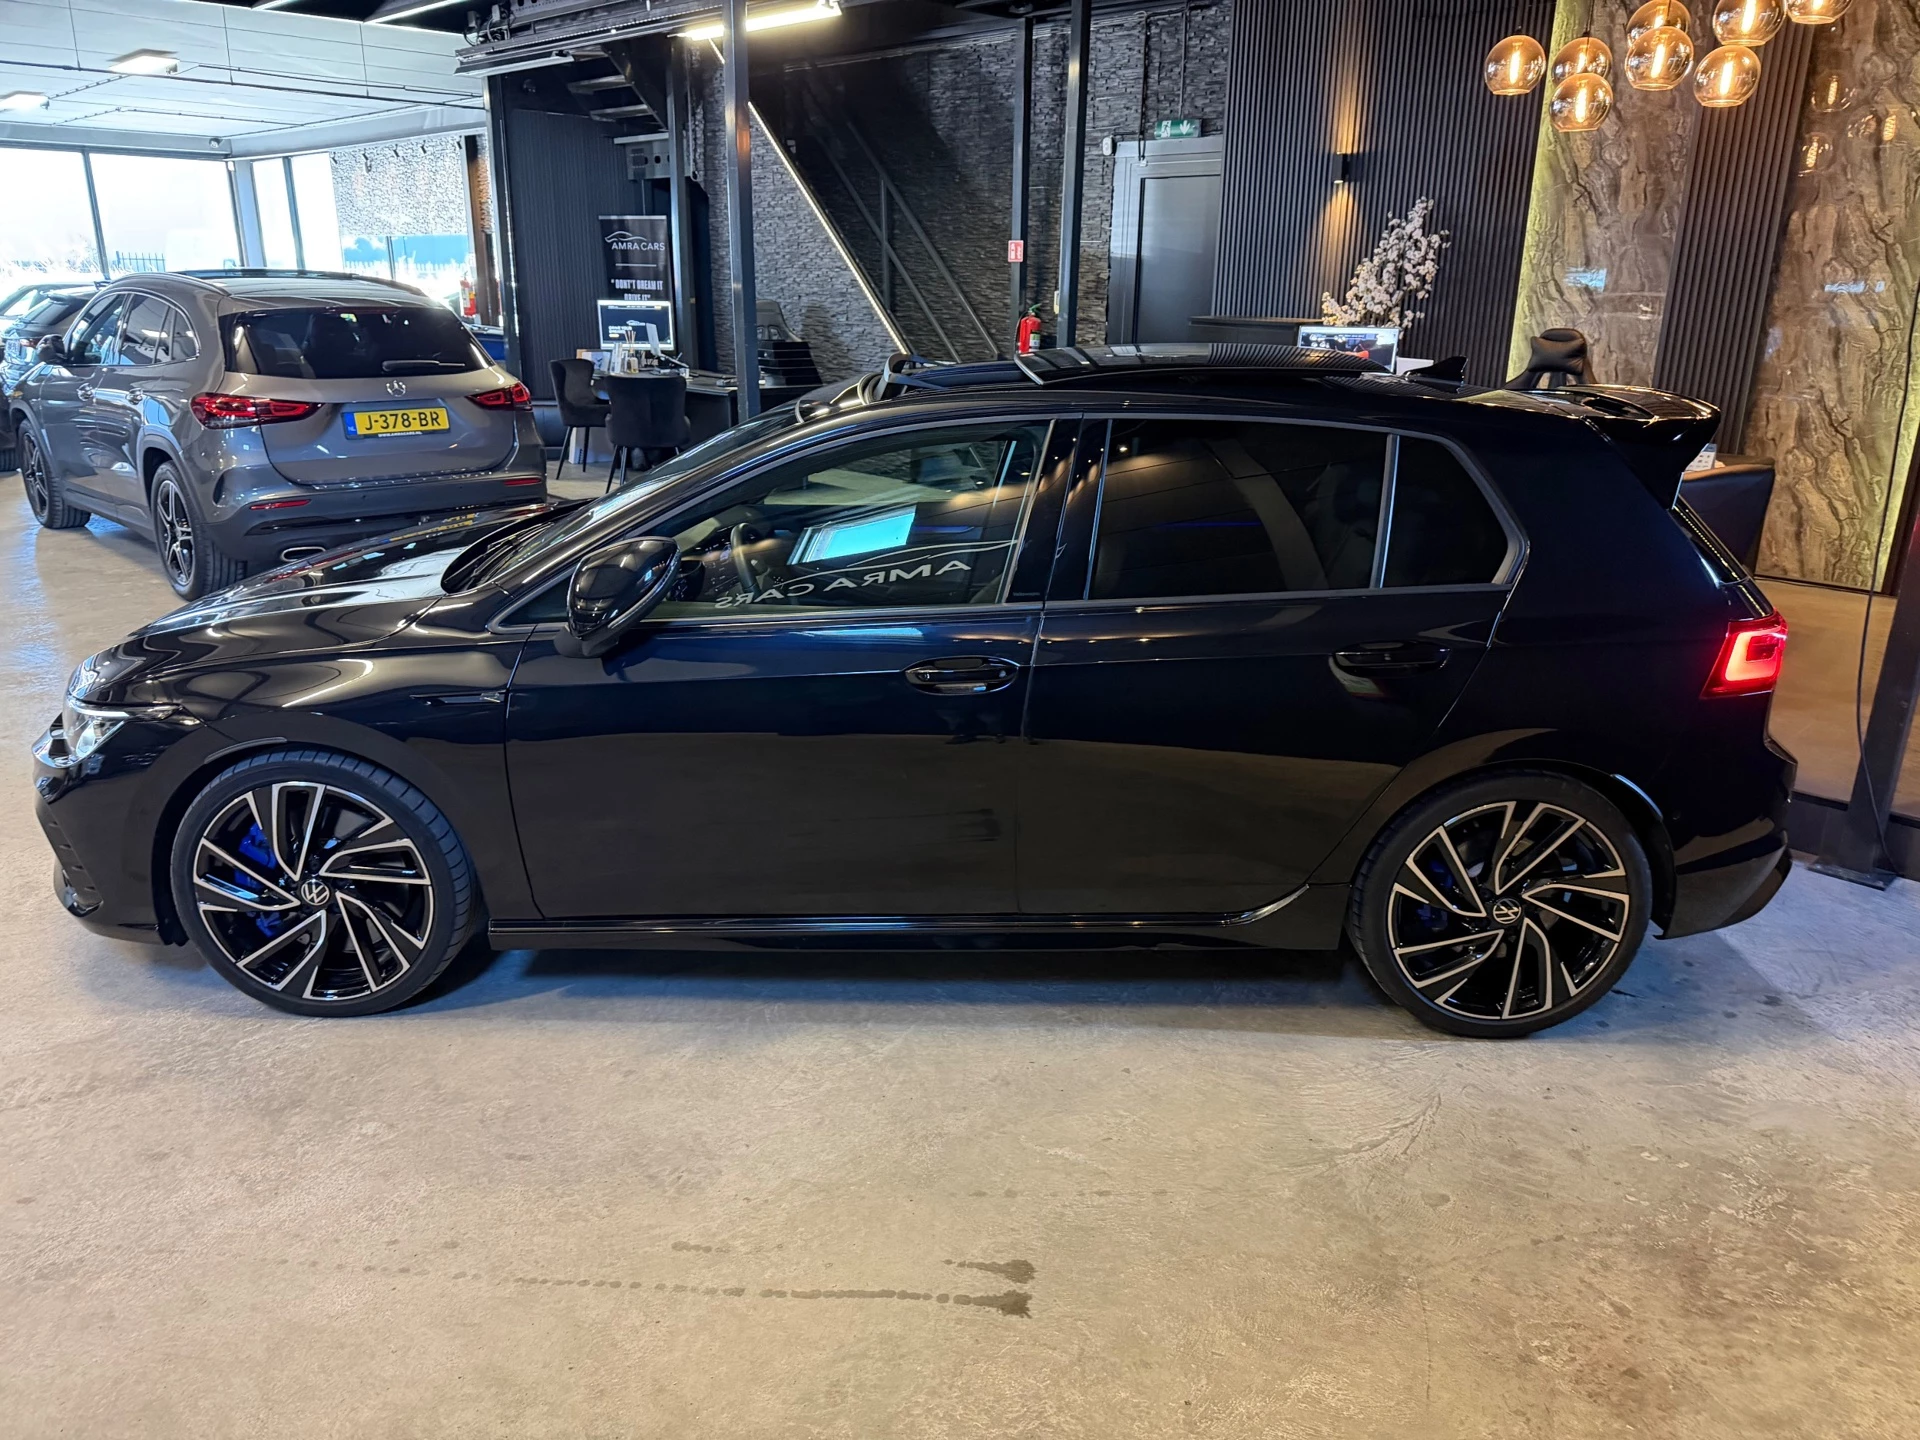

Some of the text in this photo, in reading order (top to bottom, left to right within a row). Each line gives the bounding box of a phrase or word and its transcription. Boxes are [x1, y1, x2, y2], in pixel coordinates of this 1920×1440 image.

[611, 242, 666, 251] AMRA CARS
[636, 279, 656, 290] DREAM
[657, 280, 663, 290] IT
[365, 411, 441, 431] J-378-BR
